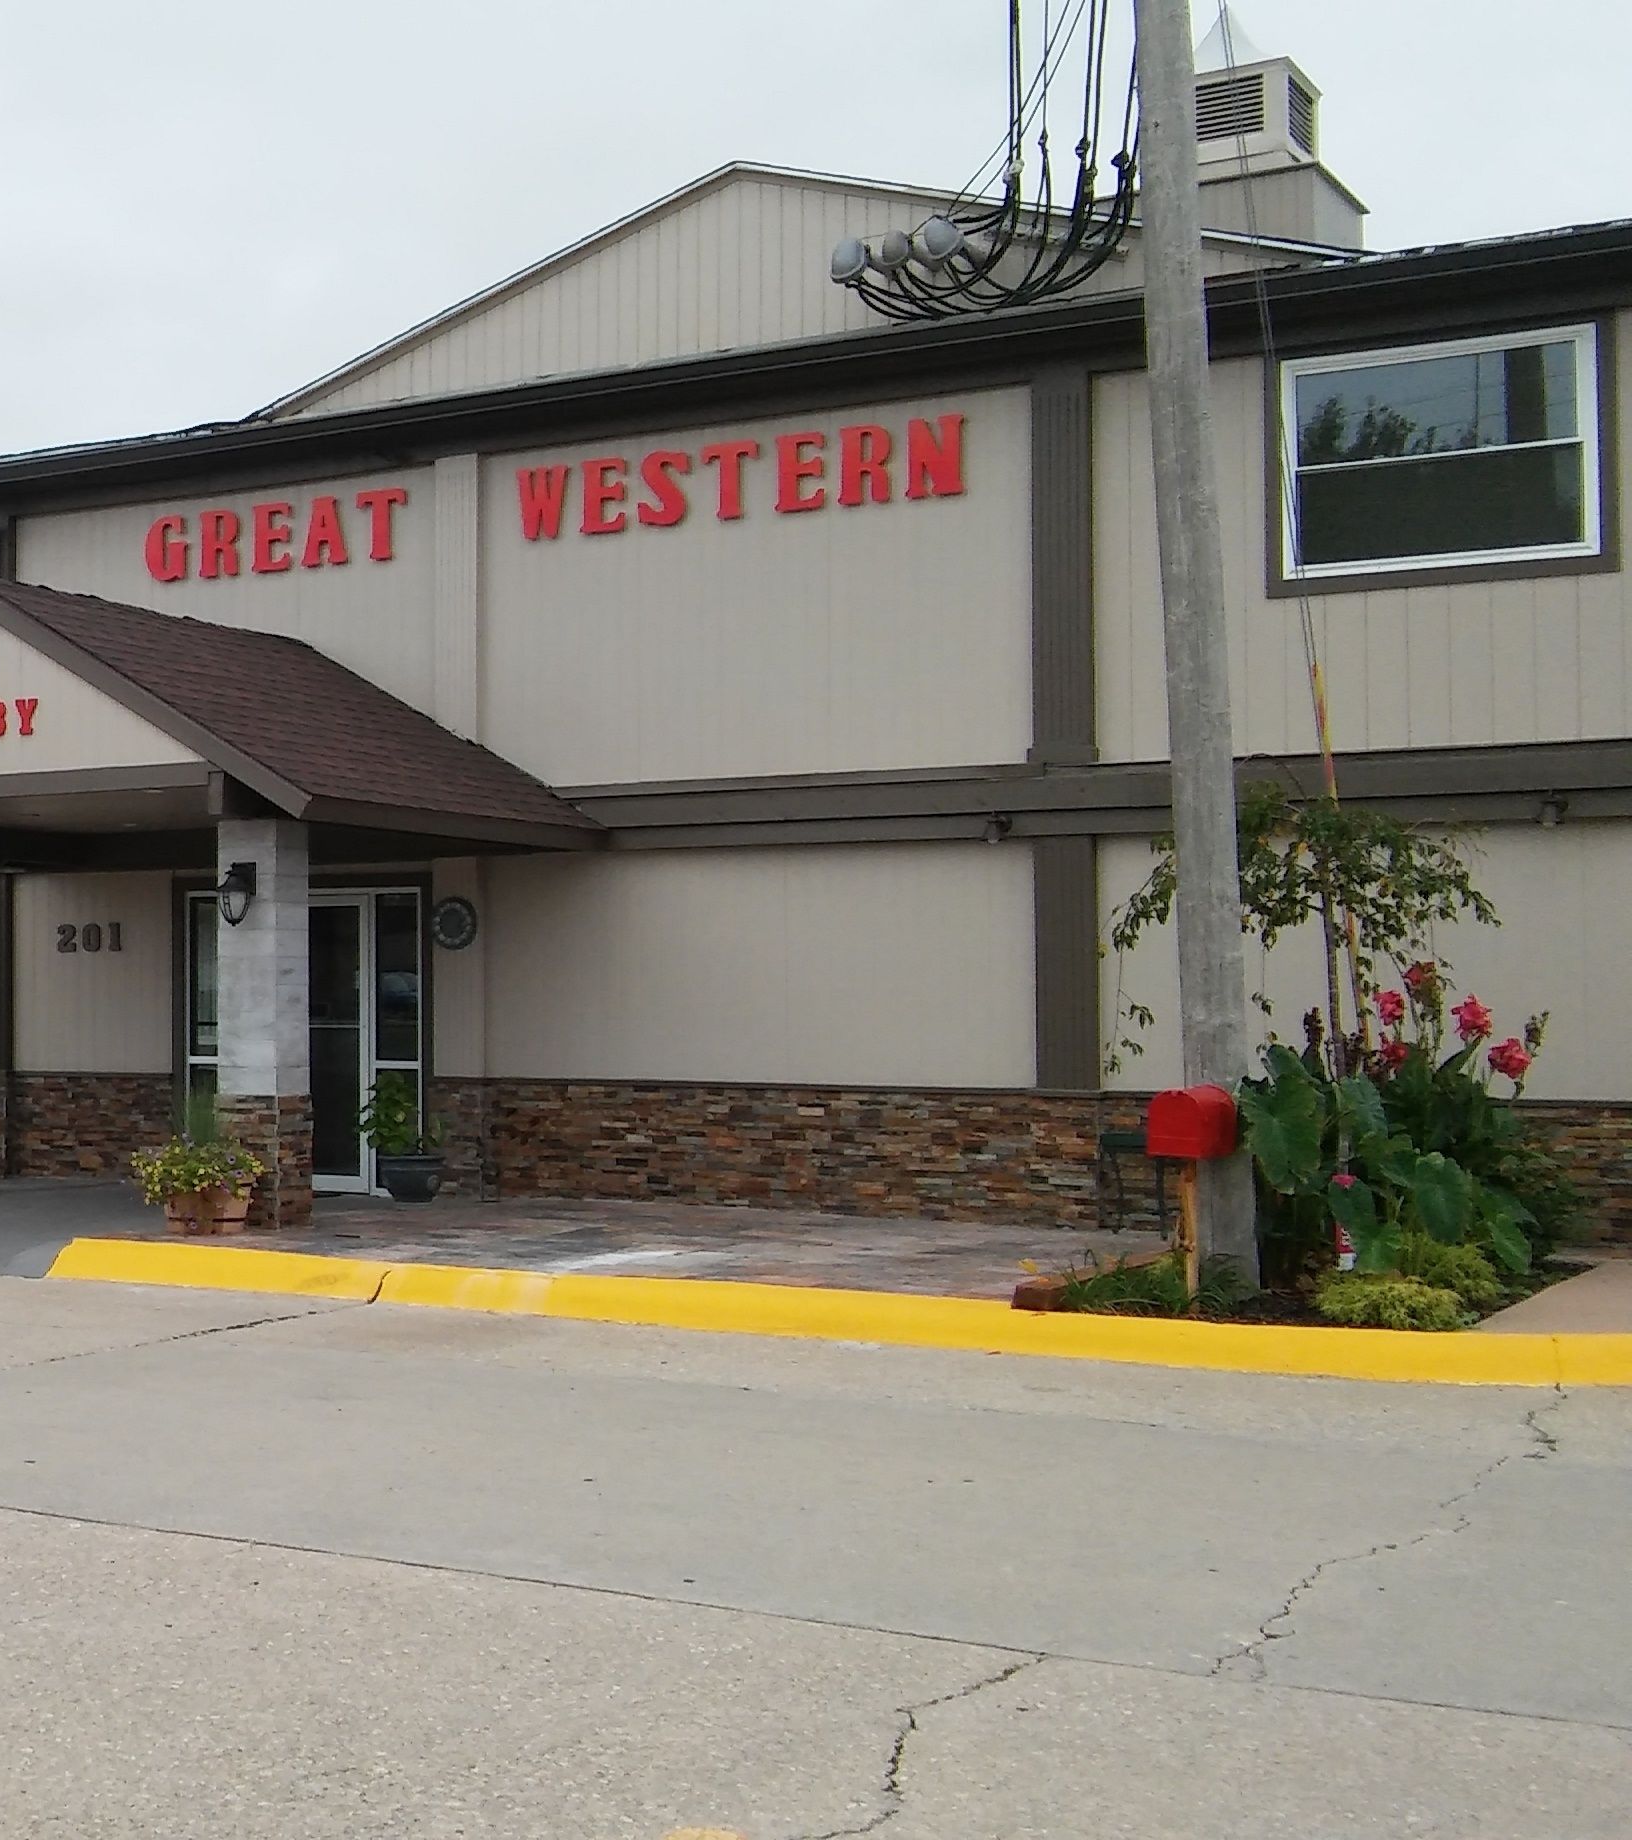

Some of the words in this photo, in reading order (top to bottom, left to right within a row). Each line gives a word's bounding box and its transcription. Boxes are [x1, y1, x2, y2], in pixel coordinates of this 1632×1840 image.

[144, 487, 408, 583] GREAT
[517, 413, 966, 543] WESTERN
[57, 921, 122, 954] 201
